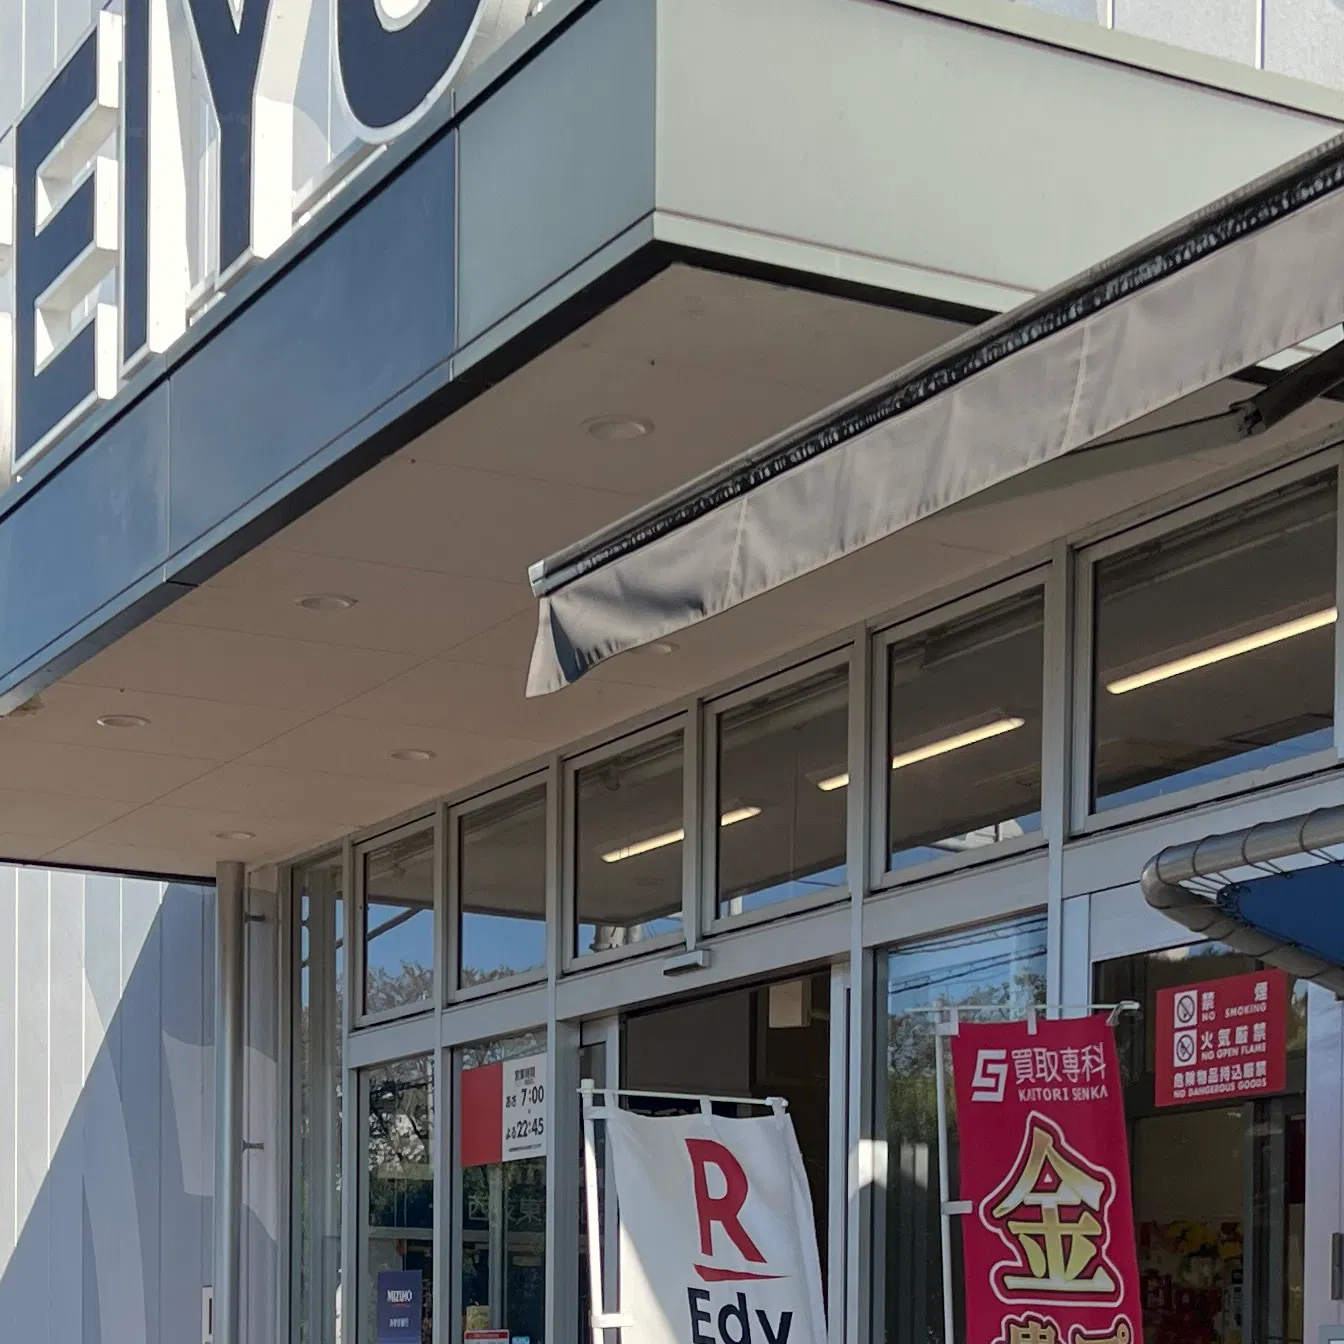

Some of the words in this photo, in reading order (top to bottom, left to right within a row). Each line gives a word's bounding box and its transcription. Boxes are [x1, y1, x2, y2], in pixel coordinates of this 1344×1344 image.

[1201, 1011, 1215, 1021] NO
[1224, 1002, 1267, 1019] SMOKING
[1201, 1051, 1215, 1061] NO
[1217, 1047, 1238, 1059] OPEN
[1241, 1042, 1266, 1055] FLAME
[1011, 1042, 1107, 1085] 買取専科
[521, 1085, 545, 1107] 7:00
[1018, 1086, 1069, 1102] KAITORI
[1071, 1084, 1109, 1101] SENKA
[1173, 1088, 1186, 1098] NO
[1188, 1081, 1235, 1097] DANGEROUS
[1237, 1077, 1267, 1091] GOODS
[684, 1138, 768, 1264] R
[985, 1119, 1120, 1300] 金
[387, 1290, 413, 1303] MIZUHO
